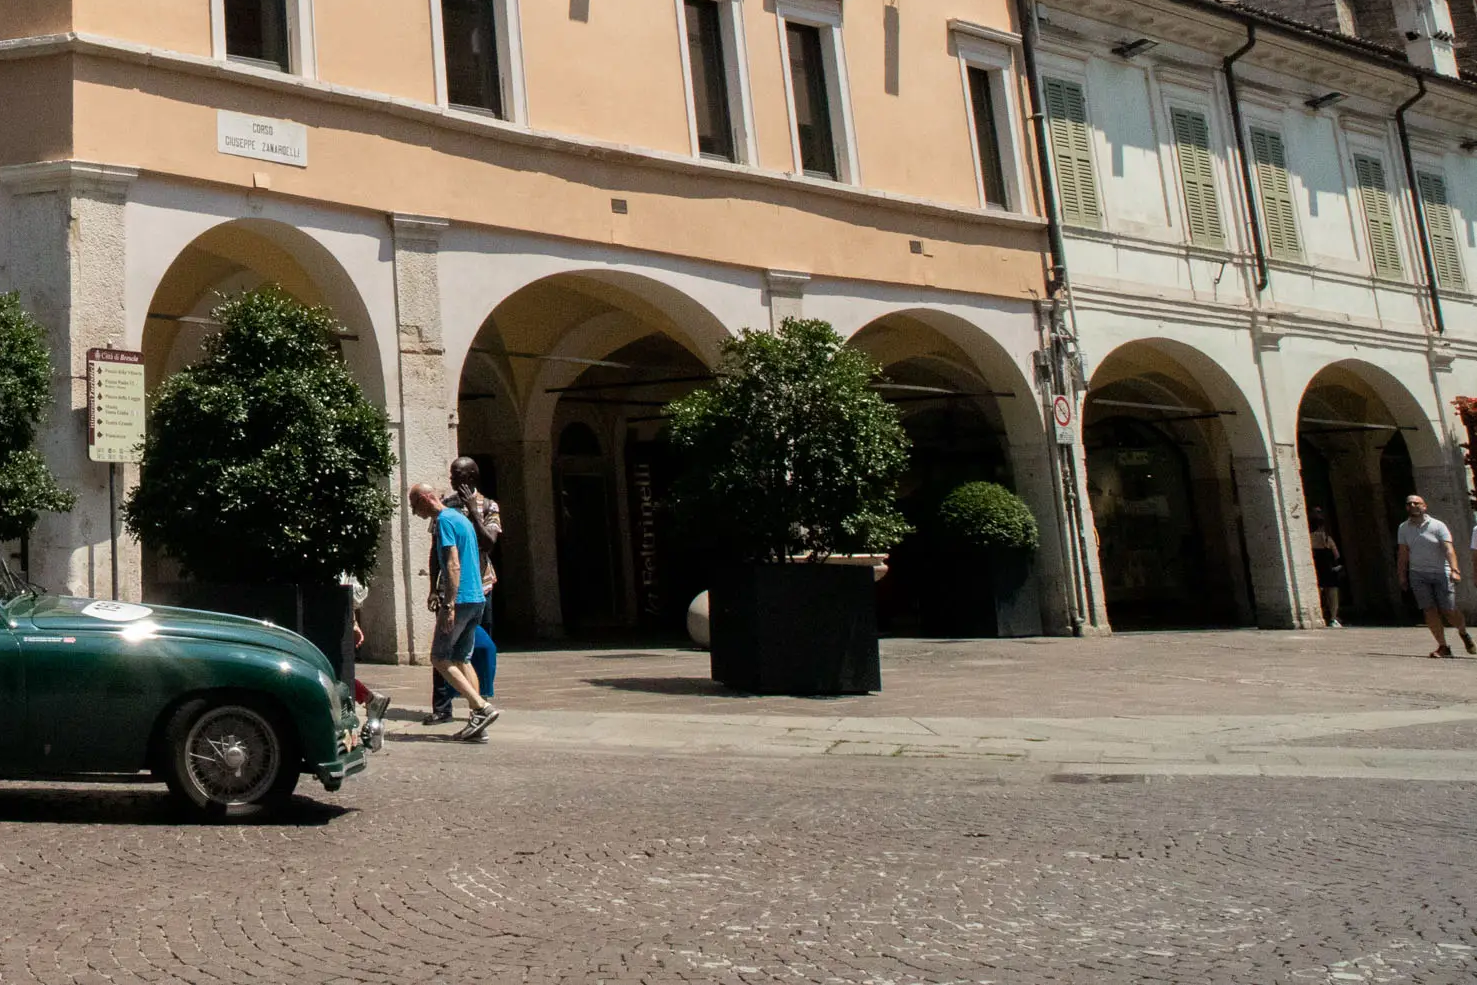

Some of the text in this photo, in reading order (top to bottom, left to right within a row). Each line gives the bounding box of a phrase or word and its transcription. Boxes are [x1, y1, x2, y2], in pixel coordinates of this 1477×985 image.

[252, 122, 274, 136] CORSO
[225, 135, 301, 160] GIUSEPPE ZANARDELLI
